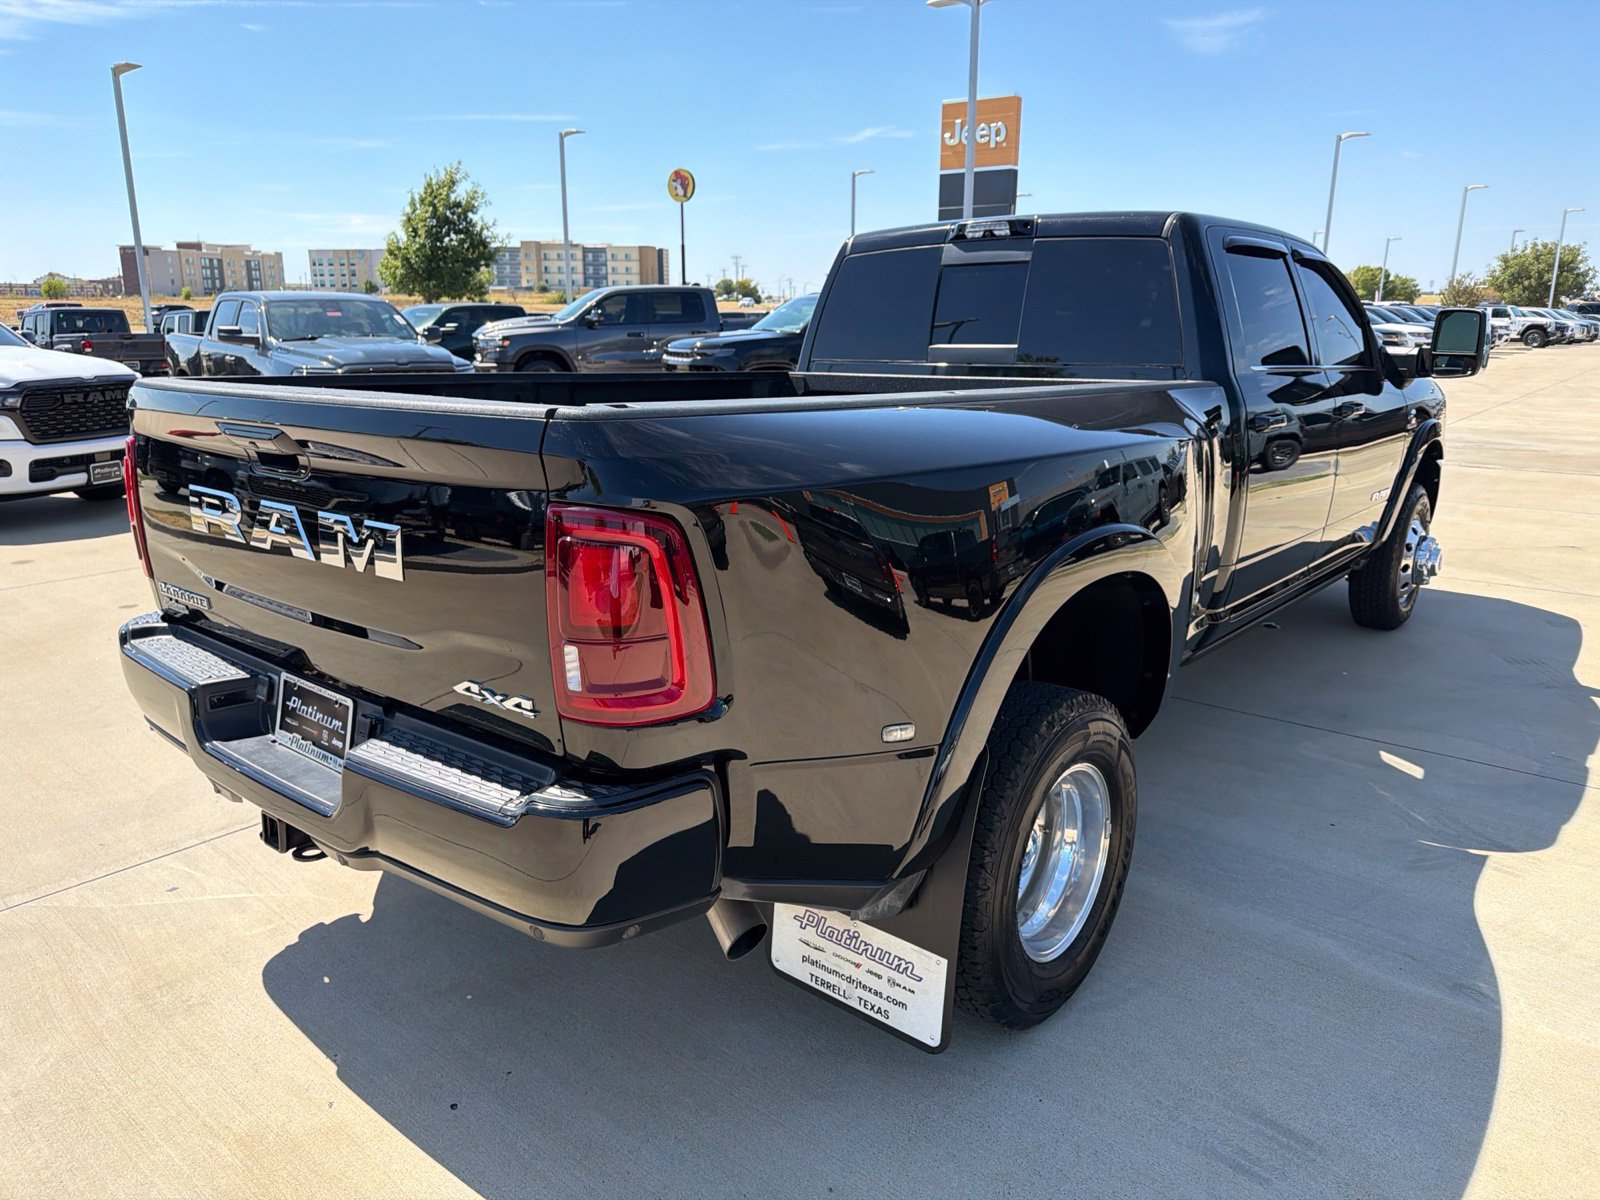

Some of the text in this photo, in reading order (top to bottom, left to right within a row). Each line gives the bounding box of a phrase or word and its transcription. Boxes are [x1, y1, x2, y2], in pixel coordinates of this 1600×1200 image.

[63, 390, 121, 404] RAM
[188, 483, 404, 582] RAM
[286, 696, 345, 734] Platinum
[288, 735, 334, 764] Platinum
[793, 909, 923, 982] Platinum
[801, 954, 908, 1012] platinumcdrjtexas.com
[832, 951, 856, 966] DODGE
[865, 968, 883, 981] Jeep
[895, 983, 916, 996] RAM
[857, 996, 890, 1020] TEXAS
